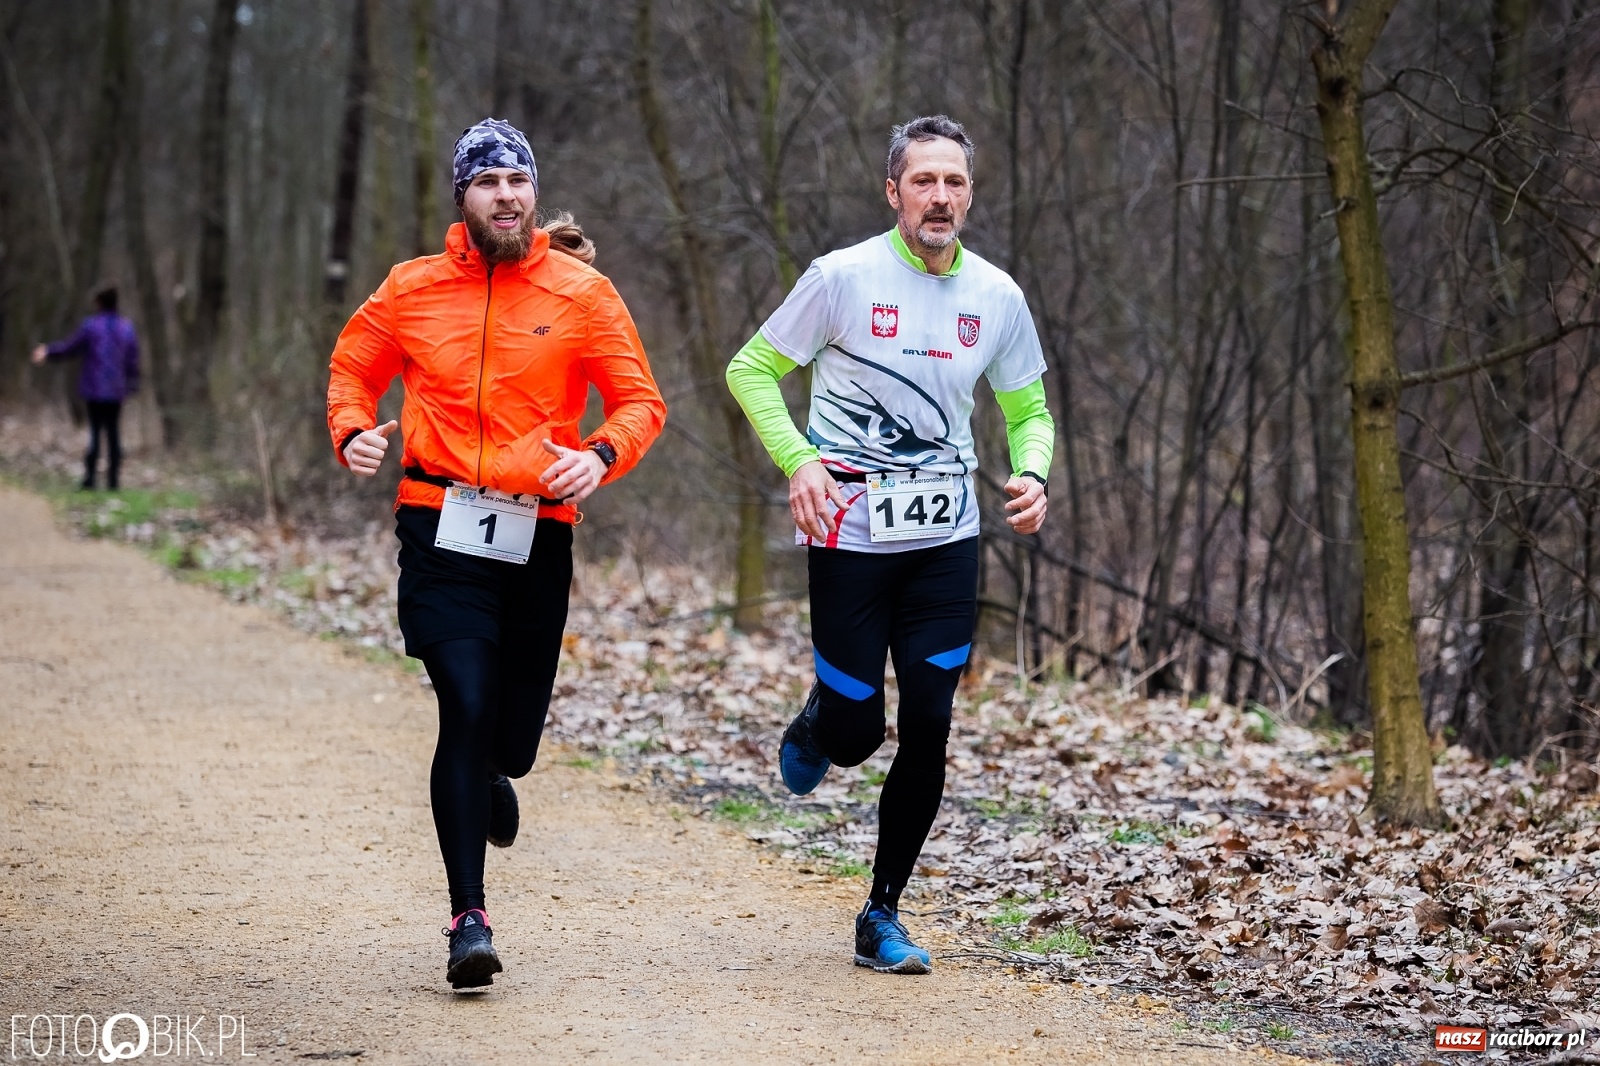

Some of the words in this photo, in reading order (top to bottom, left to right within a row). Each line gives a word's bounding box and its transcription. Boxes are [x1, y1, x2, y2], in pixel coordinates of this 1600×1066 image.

[532, 326, 551, 336] 4F
[480, 494, 535, 510] www.personalbest.pl
[875, 493, 951, 528] 142
[478, 513, 498, 545] 1
